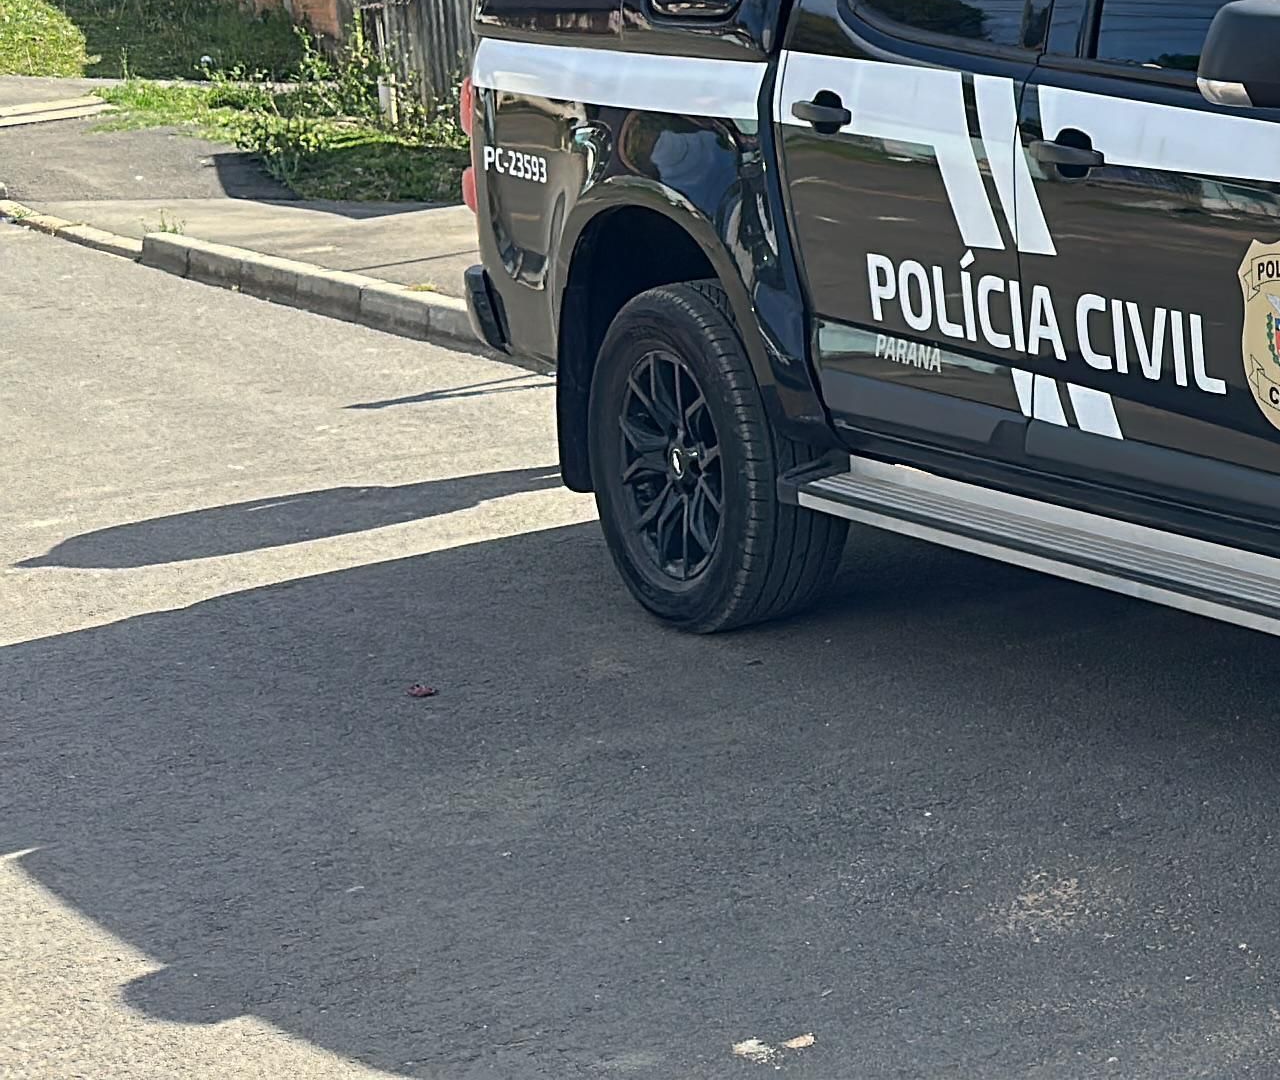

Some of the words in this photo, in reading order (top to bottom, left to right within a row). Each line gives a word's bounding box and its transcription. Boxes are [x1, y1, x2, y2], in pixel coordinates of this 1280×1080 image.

[483, 145, 548, 184] PC-23593
[866, 249, 1067, 362] POLÍCIA
[1075, 293, 1227, 395] CIVIL
[875, 333, 942, 373] PARANÁ
